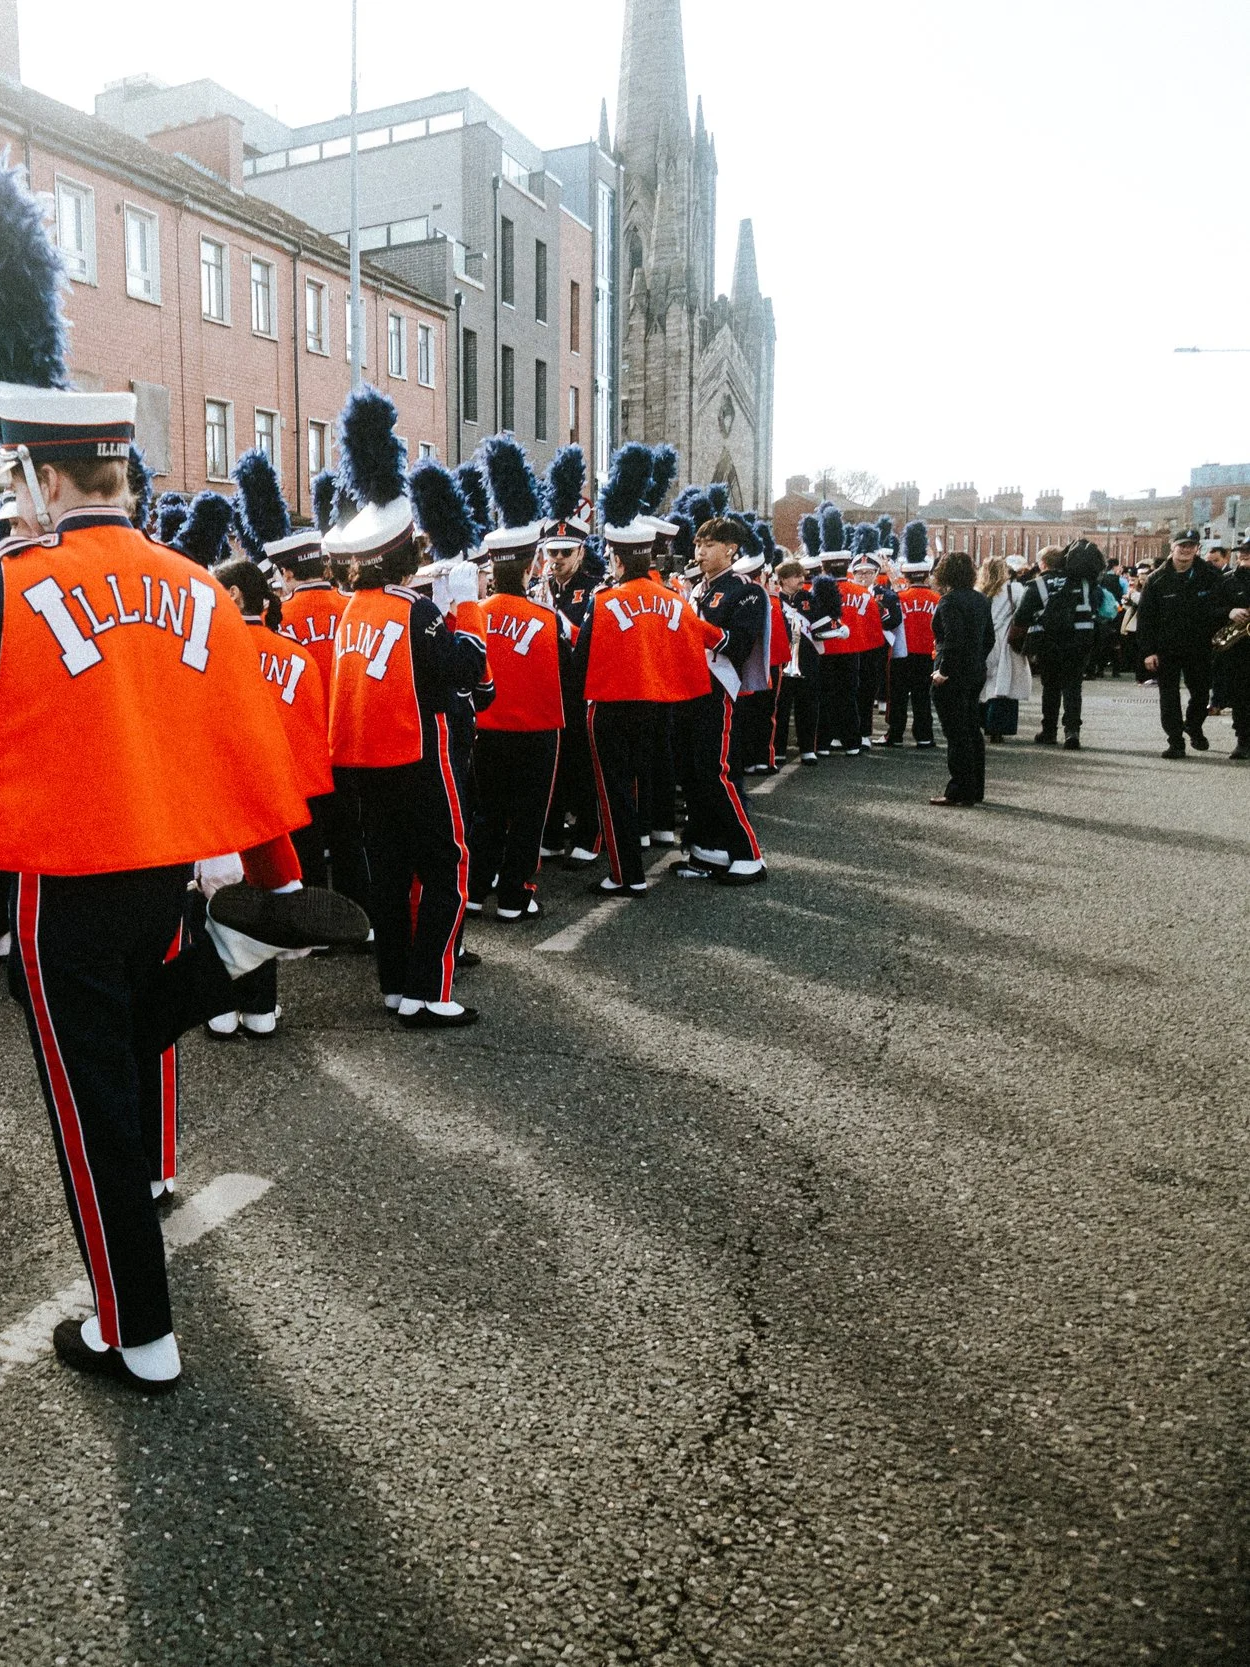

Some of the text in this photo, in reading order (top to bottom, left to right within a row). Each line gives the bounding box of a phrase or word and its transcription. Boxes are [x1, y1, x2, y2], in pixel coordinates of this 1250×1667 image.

[557, 523, 566, 536] I
[571, 589, 585, 604] I
[709, 592, 724, 608] I
[604, 595, 683, 632] ILLINI
[22, 574, 217, 678] ILLINI
